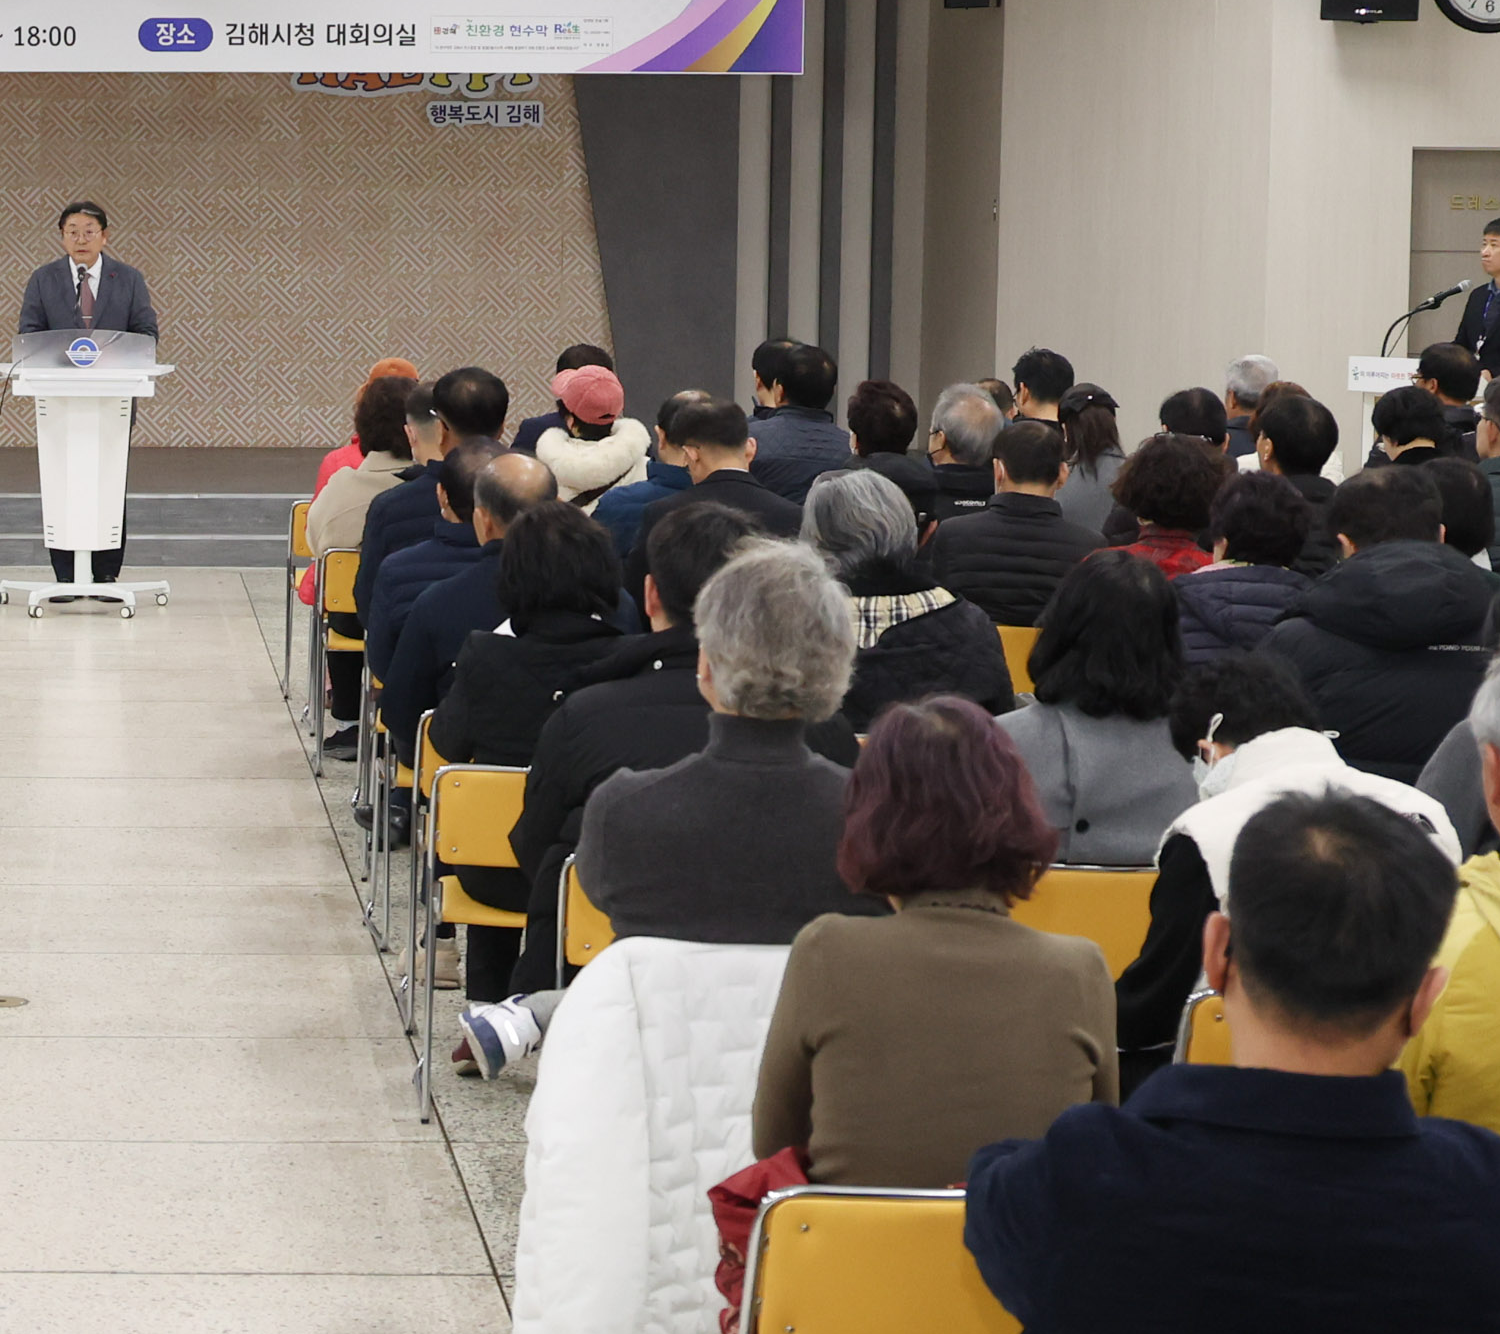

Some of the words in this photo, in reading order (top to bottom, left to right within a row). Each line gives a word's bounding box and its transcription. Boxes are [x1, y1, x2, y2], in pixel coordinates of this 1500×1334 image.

[1485, 0, 1495, 13] 6
[13, 25, 77, 47] 18:00
[155, 22, 196, 46] 장소
[225, 22, 315, 47] 김해시청
[326, 22, 416, 47] 대회의실
[466, 24, 505, 37] 친환경
[509, 24, 548, 37] 현수막
[430, 104, 499, 124] 행복도시
[506, 104, 540, 123] 김해
